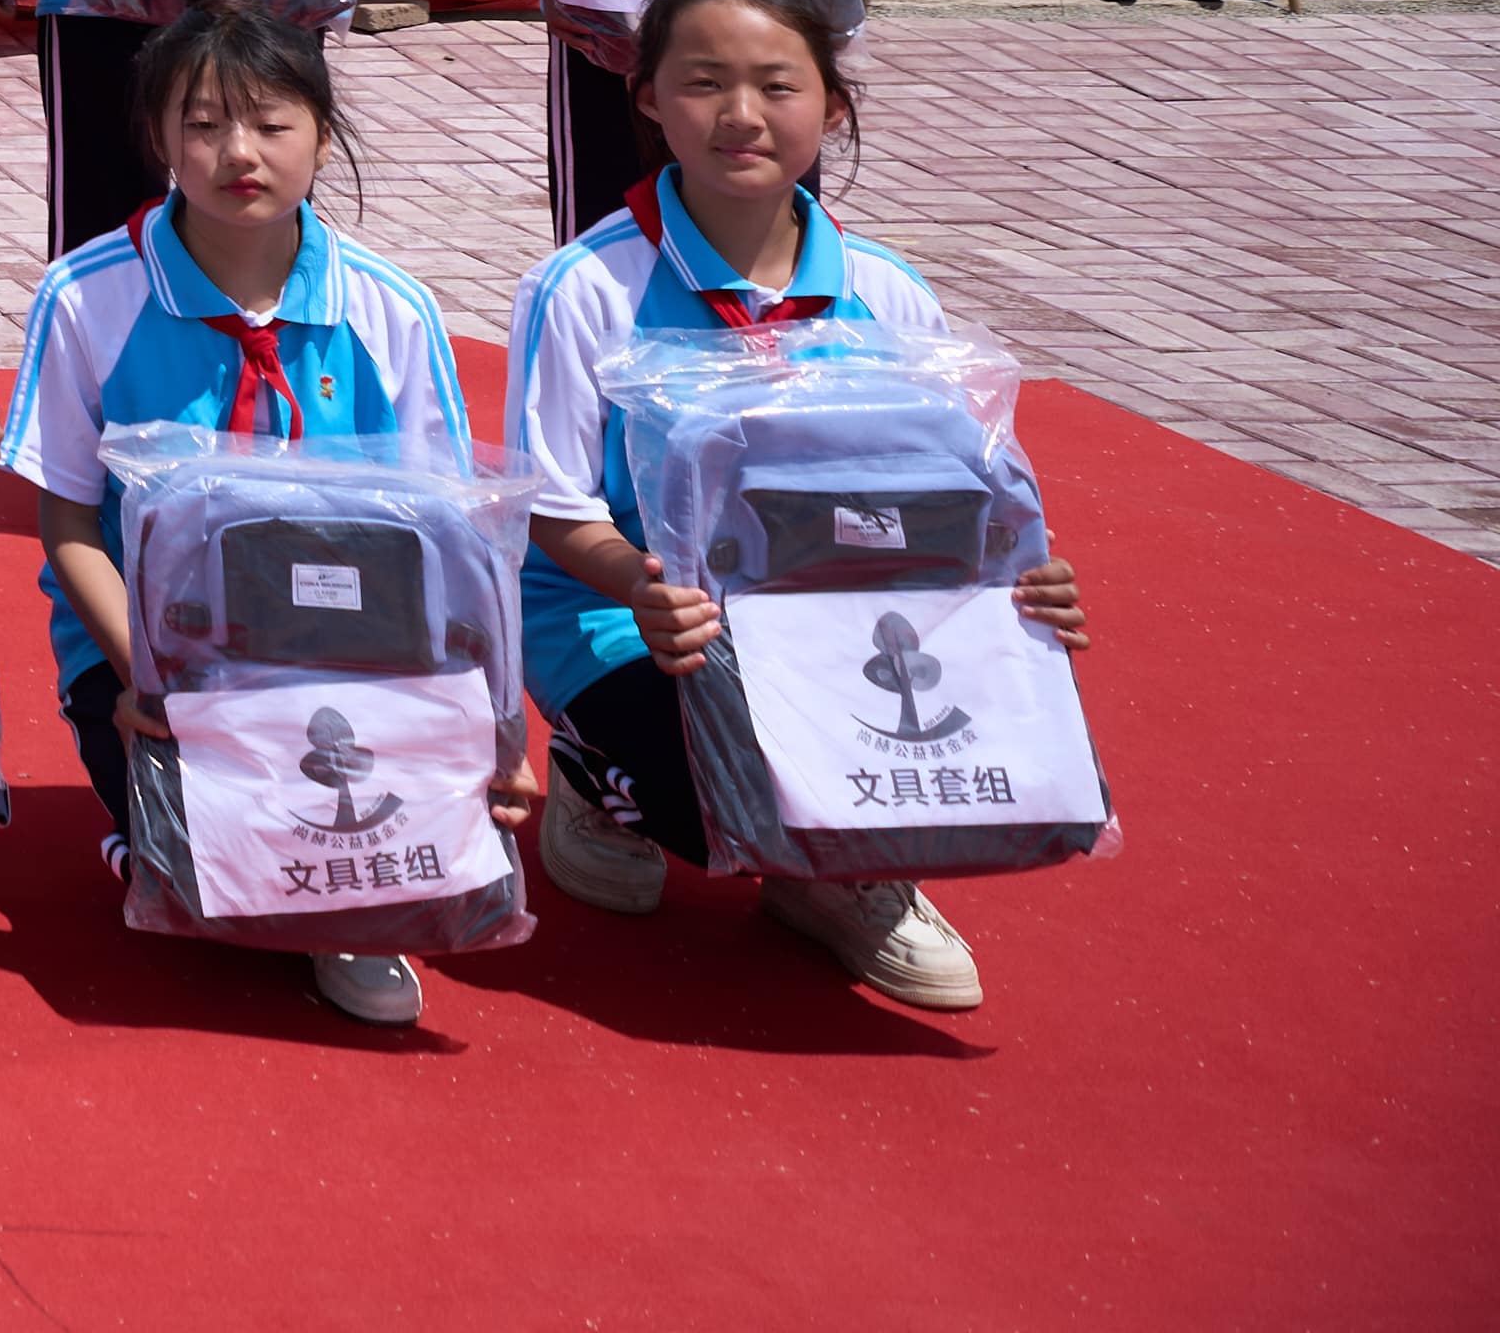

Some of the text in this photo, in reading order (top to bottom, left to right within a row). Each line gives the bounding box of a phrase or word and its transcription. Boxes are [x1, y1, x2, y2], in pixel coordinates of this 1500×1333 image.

[856, 729, 978, 760] 尚赫公益基金会
[845, 765, 1017, 807] 文具套组
[290, 811, 410, 850] 尚赫公益基金会
[280, 844, 446, 897] 文具套组
